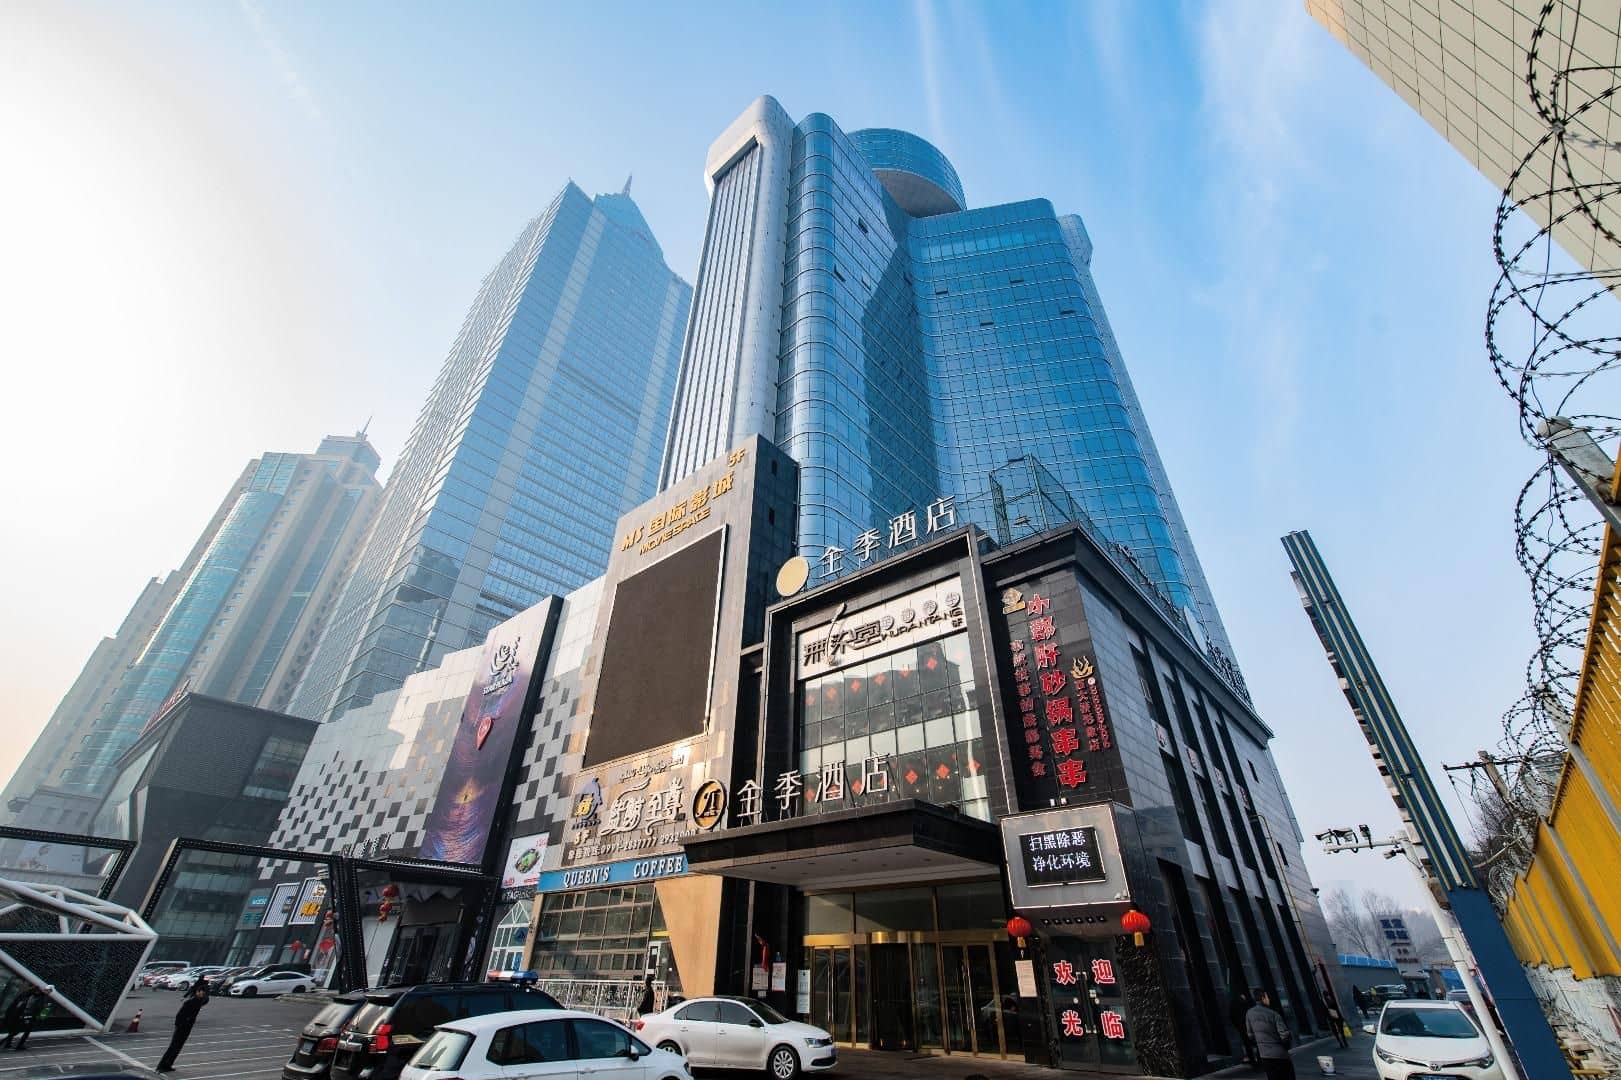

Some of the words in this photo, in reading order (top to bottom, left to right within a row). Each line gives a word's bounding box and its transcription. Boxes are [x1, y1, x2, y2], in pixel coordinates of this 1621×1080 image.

[819, 495, 956, 578] 全季酒店
[736, 751, 891, 818] 全季酒店
[1029, 830, 1086, 851] 扫黑除恶
[563, 866, 611, 888] QUEEN'S
[633, 855, 684, 878] COFFEE
[1032, 851, 1091, 873] 净化环境
[1053, 959, 1115, 985] 欢迎
[1061, 1010, 1125, 1039] 光临
